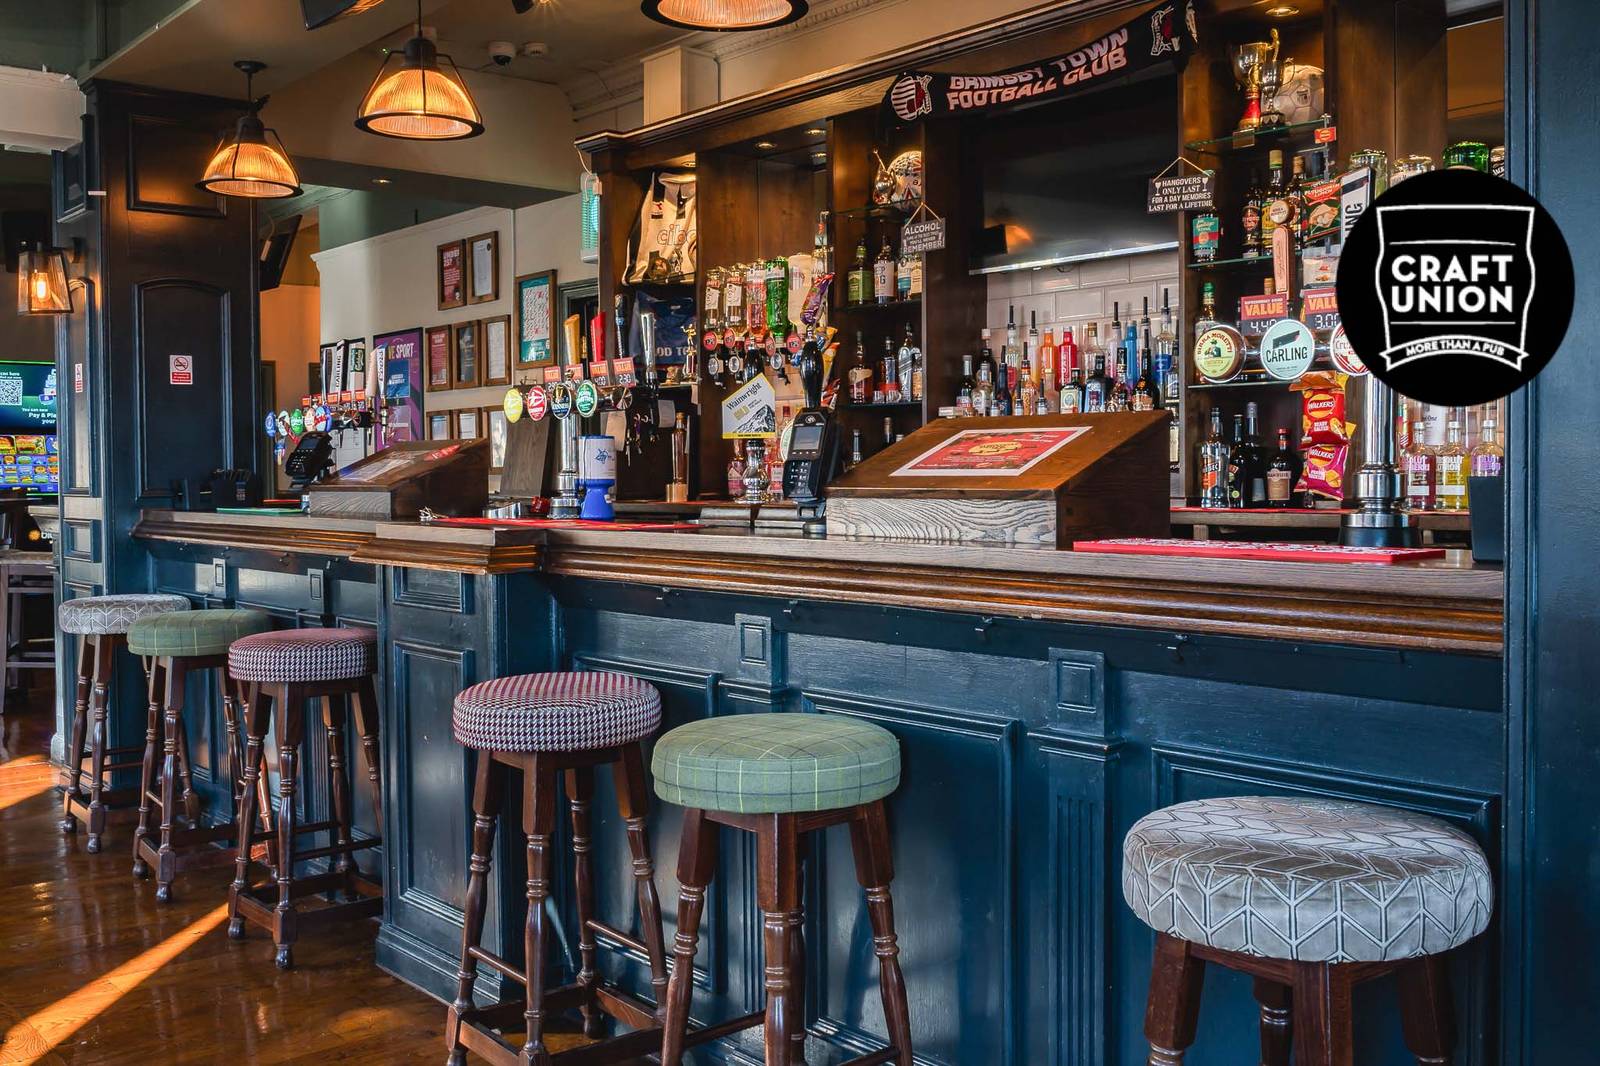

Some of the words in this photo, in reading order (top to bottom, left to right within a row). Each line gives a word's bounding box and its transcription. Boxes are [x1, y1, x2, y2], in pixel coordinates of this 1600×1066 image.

[949, 67, 1043, 90] GRIMSBY
[1049, 27, 1128, 72] TOWN
[946, 77, 1057, 111] FOOTBALL
[1062, 47, 1128, 86] CLUB
[1162, 176, 1202, 187] HANGOVERS
[1151, 196, 1163, 204] FOR
[1169, 195, 1181, 203] DAY
[1181, 192, 1212, 201] MEMORIES
[1162, 187, 1181, 196] ONLY
[1182, 185, 1200, 193] LAST
[1148, 204, 1164, 212] LAST
[1165, 203, 1177, 211] FOR
[1184, 199, 1213, 209] LIFETIME
[904, 221, 941, 236] ALCOHOL
[903, 237, 945, 252] REMEMBER!
[1244, 301, 1284, 317] VALUE
[1308, 296, 1338, 311] VALU
[396, 343, 414, 359] SPORT
[1266, 346, 1308, 363] CARLING
[726, 382, 762, 410] Wainwright
[1308, 401, 1335, 409] WALKERS
[1310, 448, 1335, 459] WALKERS
